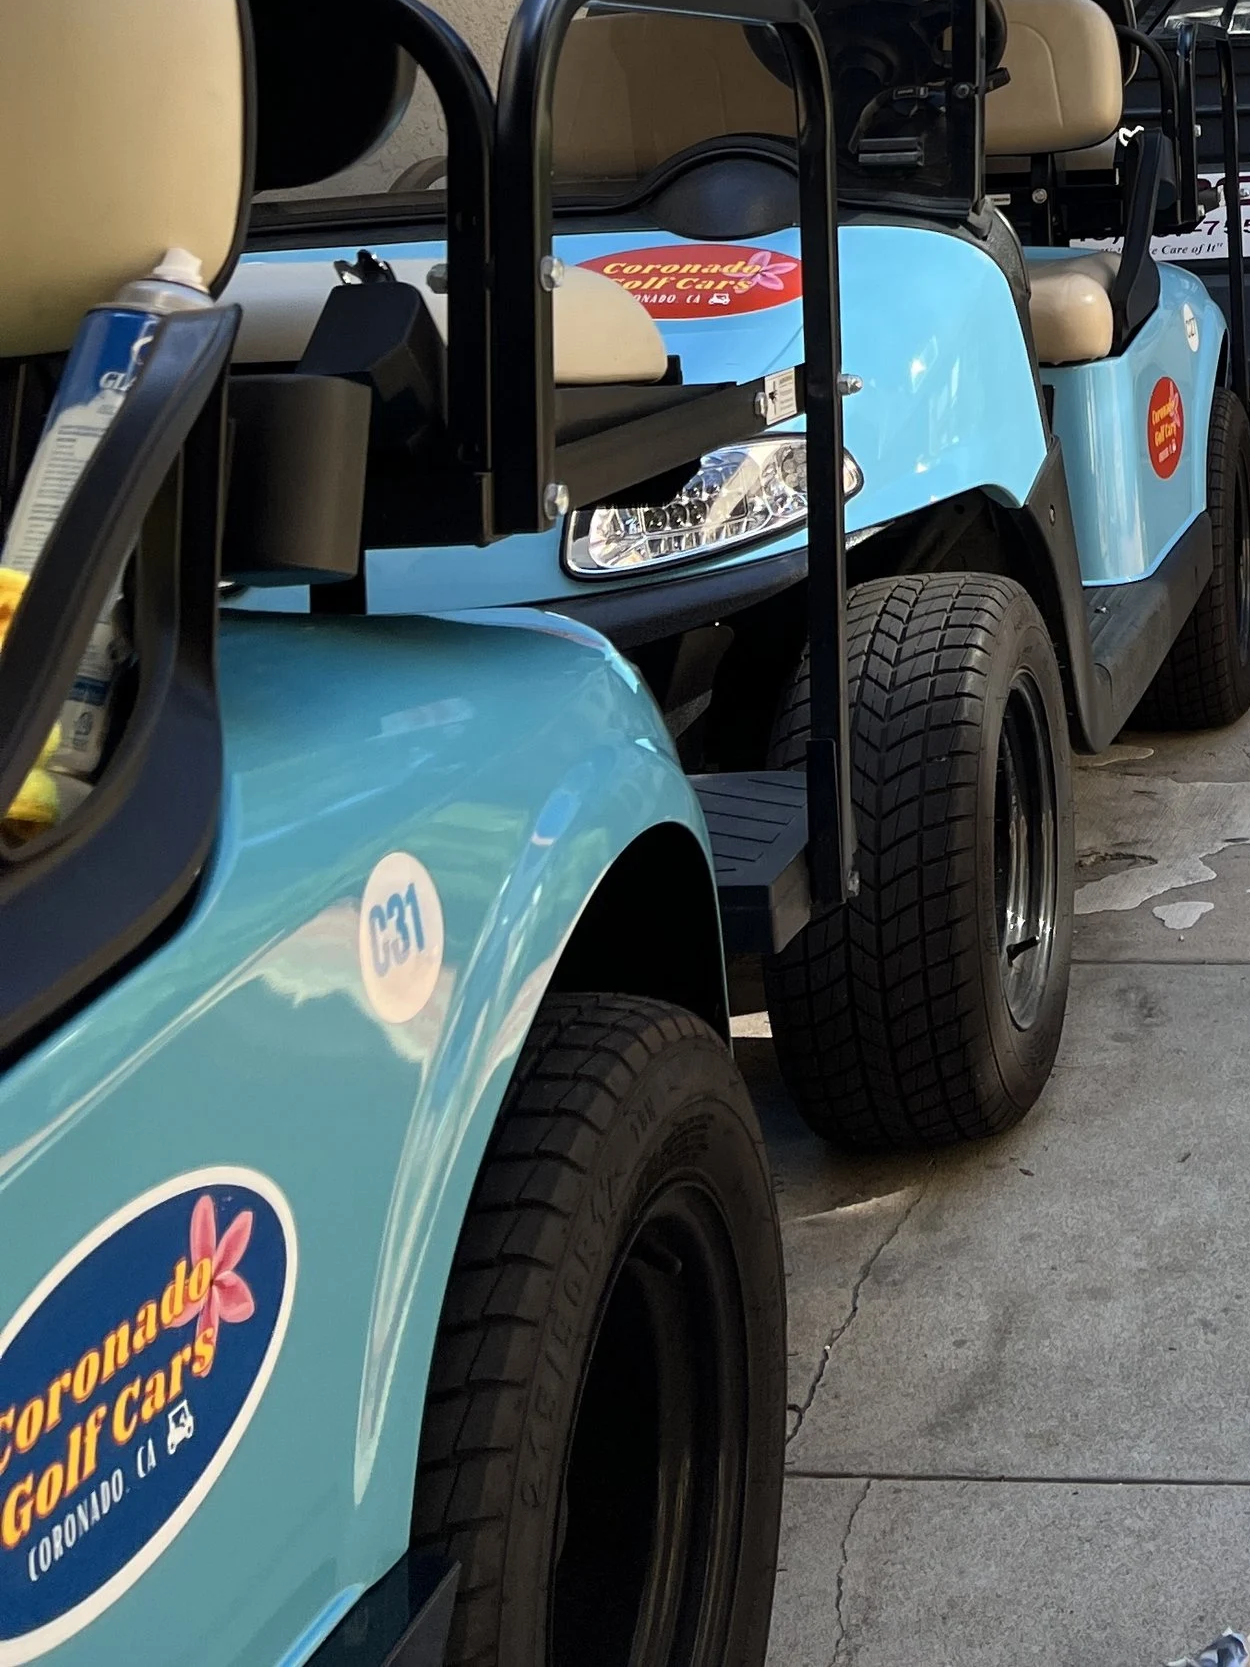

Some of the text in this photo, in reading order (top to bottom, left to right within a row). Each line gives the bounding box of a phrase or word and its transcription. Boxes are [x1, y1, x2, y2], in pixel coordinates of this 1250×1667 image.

[1161, 244, 1188, 255] Care
[1191, 243, 1205, 256] of
[602, 260, 760, 275] Coronado
[675, 277, 753, 292] Cars
[685, 293, 701, 305] CA
[368, 882, 425, 978] C31
[1, 1324, 217, 1550] Golf Cars
[135, 1435, 157, 1480] CA
